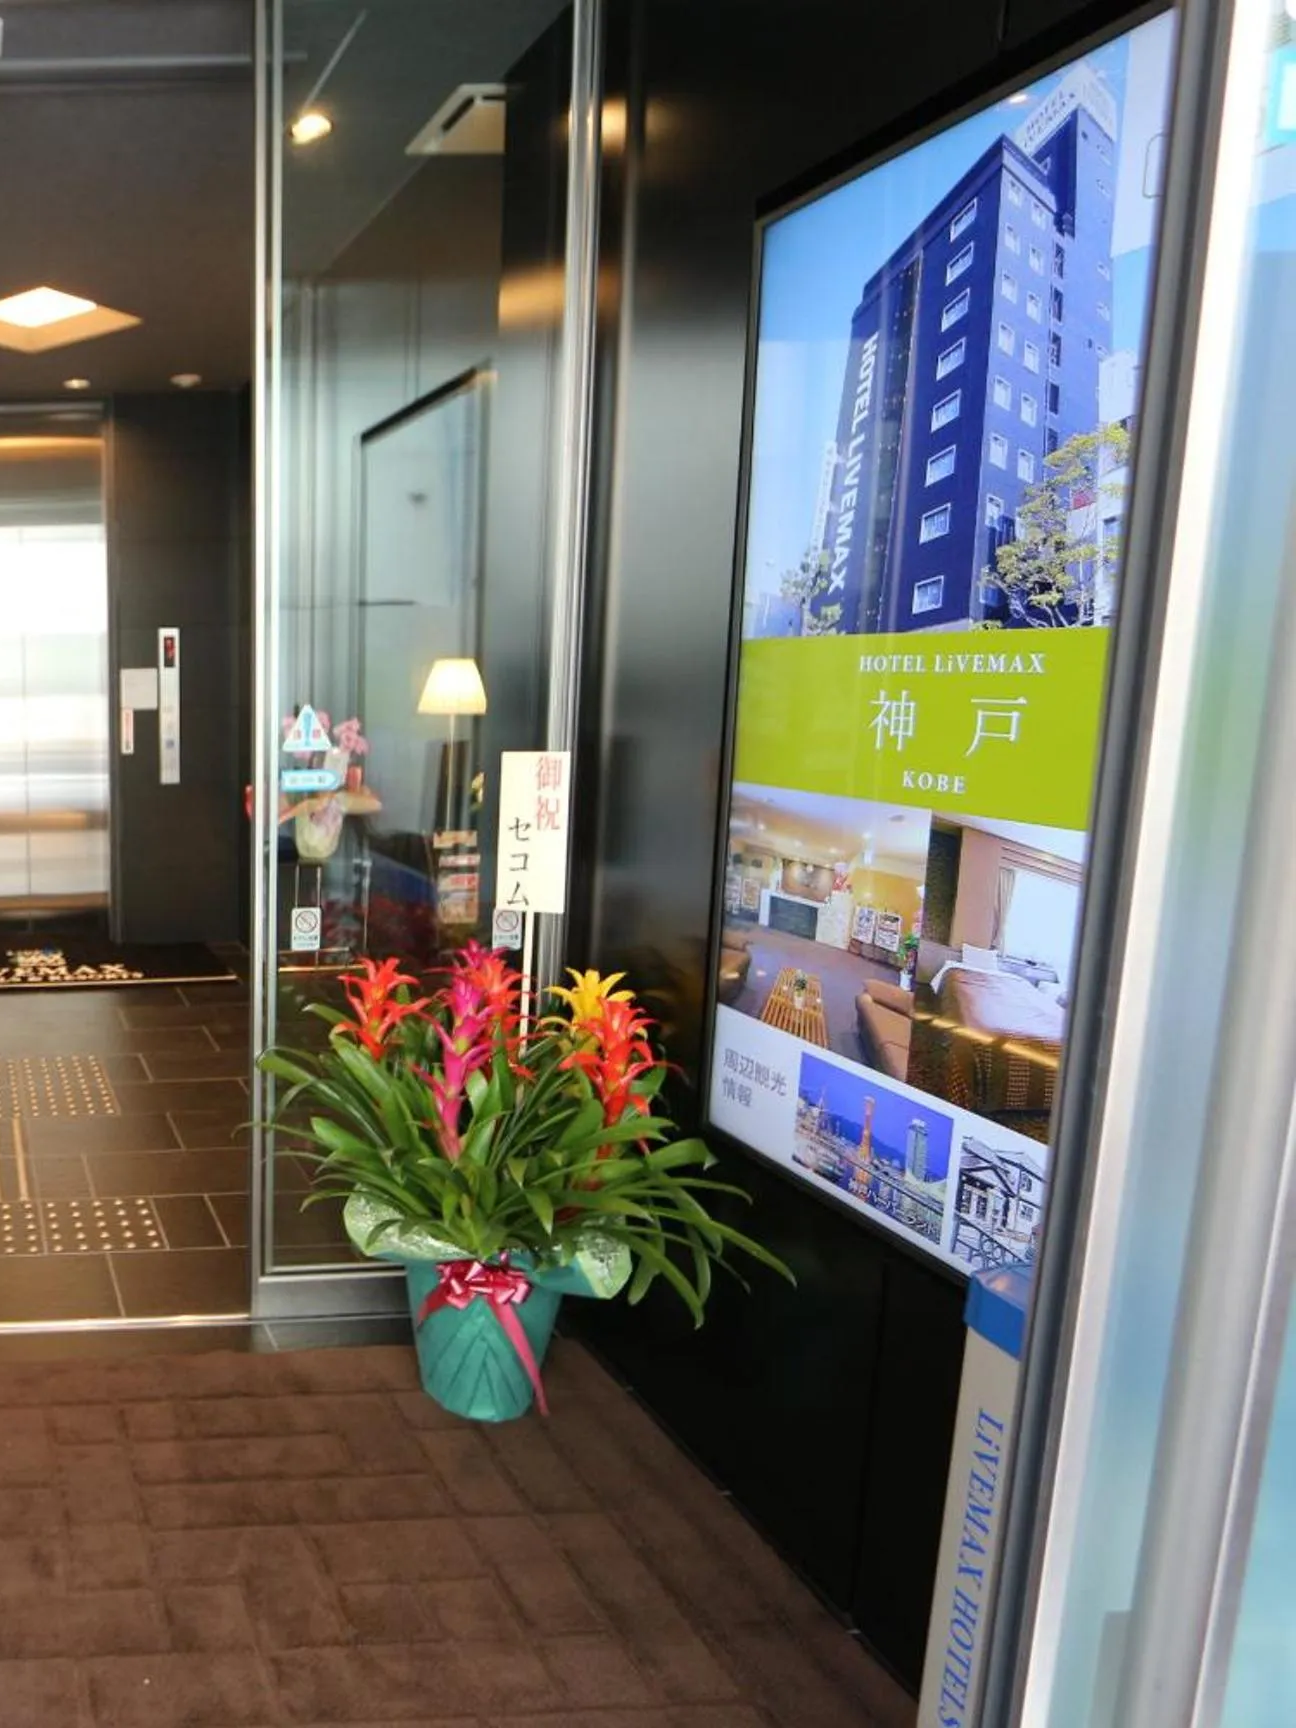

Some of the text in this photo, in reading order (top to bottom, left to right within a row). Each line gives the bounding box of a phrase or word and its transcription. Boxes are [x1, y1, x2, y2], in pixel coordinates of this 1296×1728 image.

[852, 332, 879, 434] HOTEL
[859, 655, 926, 673] HOTEL
[868, 689, 1028, 758] 神戸
[535, 757, 562, 831] 御祝
[902, 770, 967, 794] KOBE
[507, 817, 531, 906] セコム
[938, 1586, 979, 1728] HOTELS
